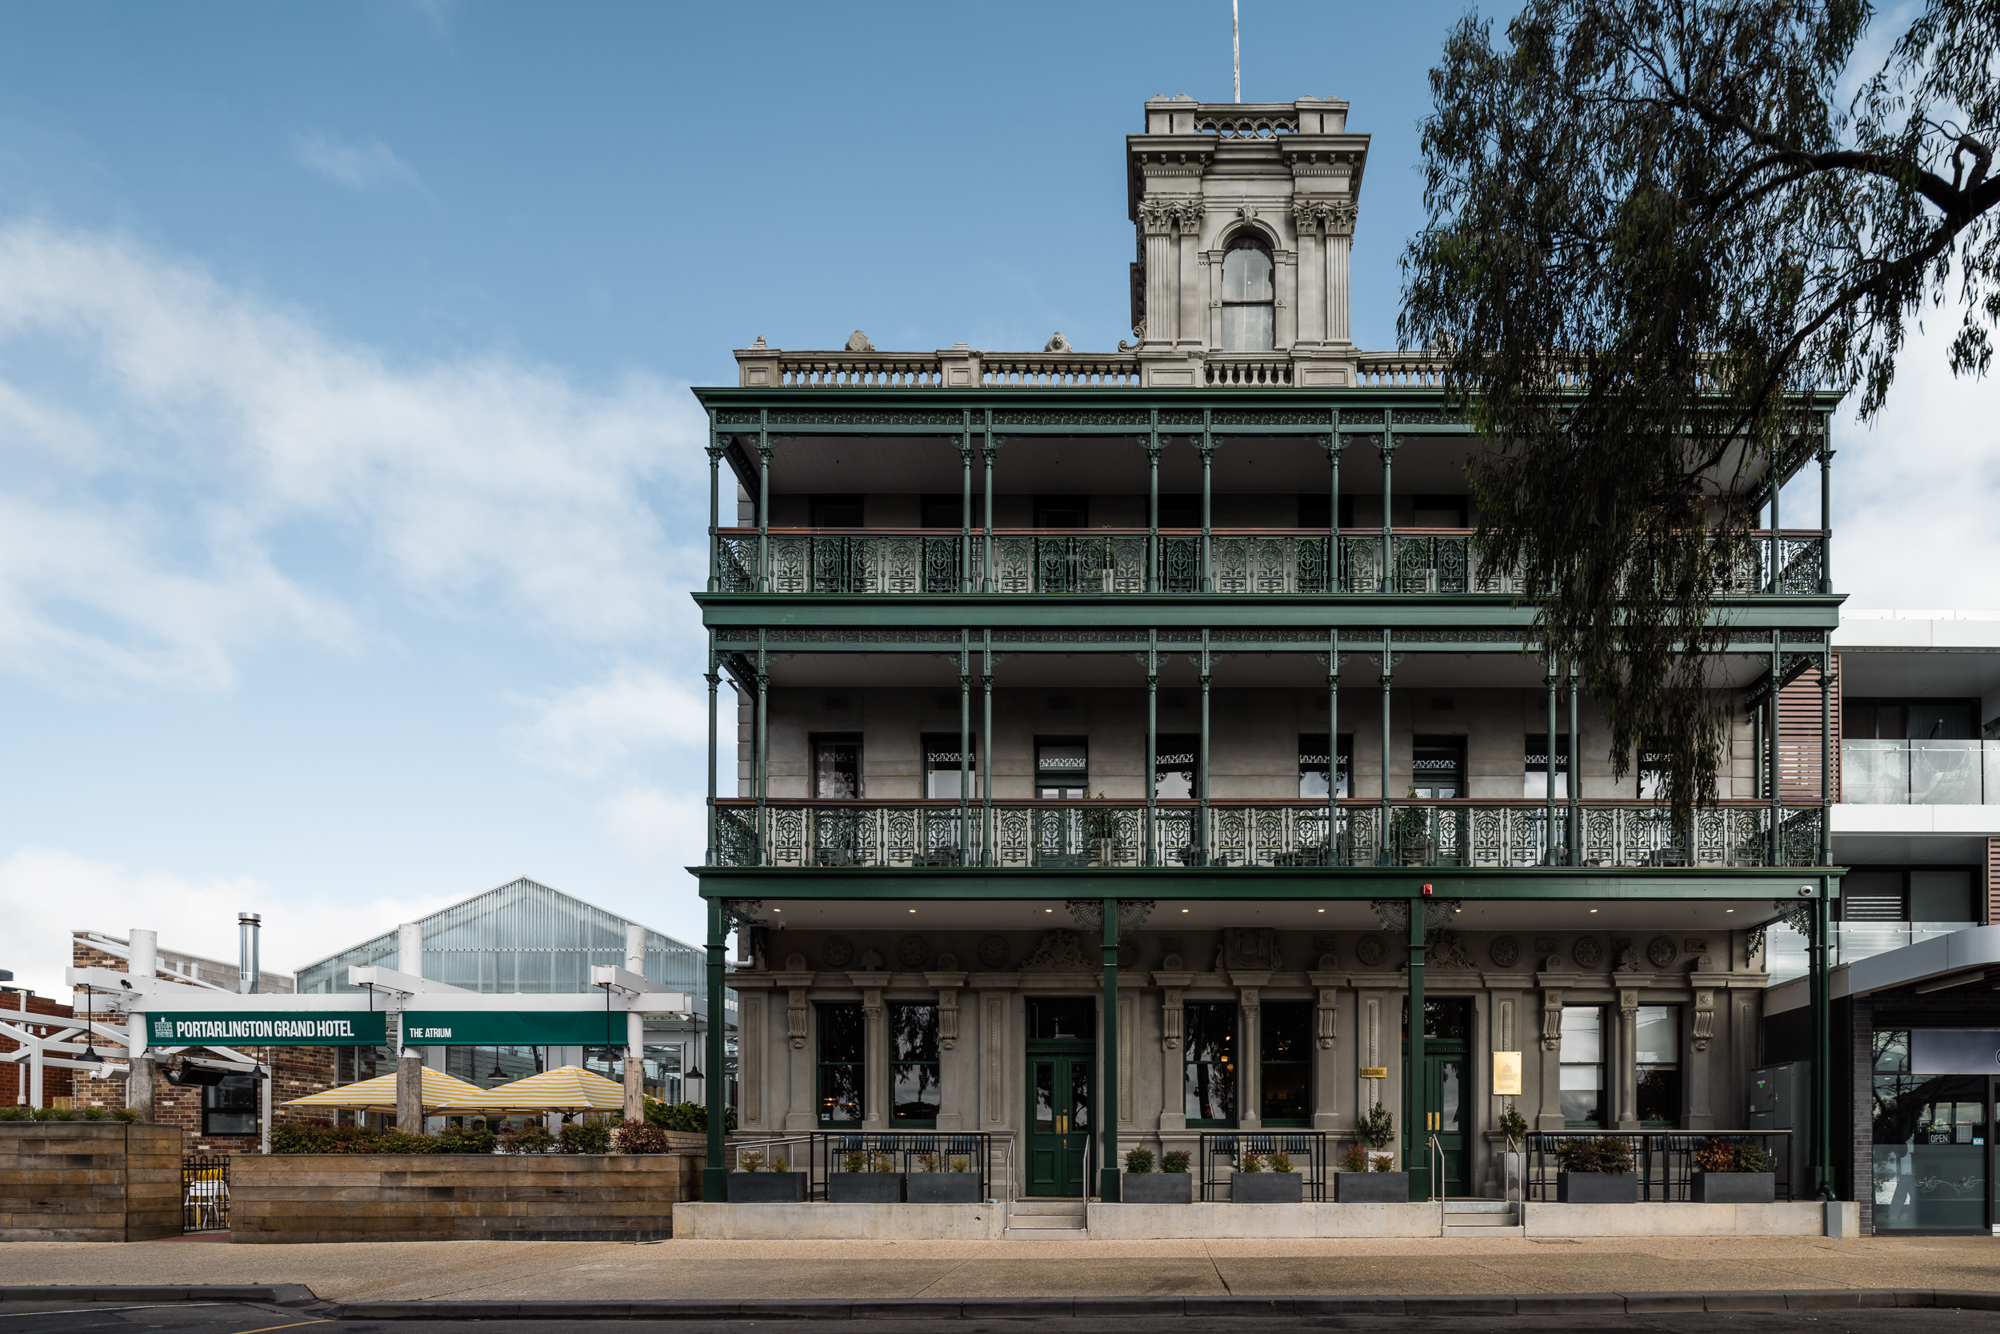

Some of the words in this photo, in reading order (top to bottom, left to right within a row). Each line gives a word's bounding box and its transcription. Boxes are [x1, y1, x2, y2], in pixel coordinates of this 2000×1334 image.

[176, 1020, 272, 1038] PORTARLINGTON
[274, 1020, 315, 1037] GRAND
[317, 1020, 355, 1037] HOTEL
[409, 1027, 423, 1038] THE
[424, 1027, 452, 1038] ATRIUM
[1930, 1134, 1948, 1143] OPEN
